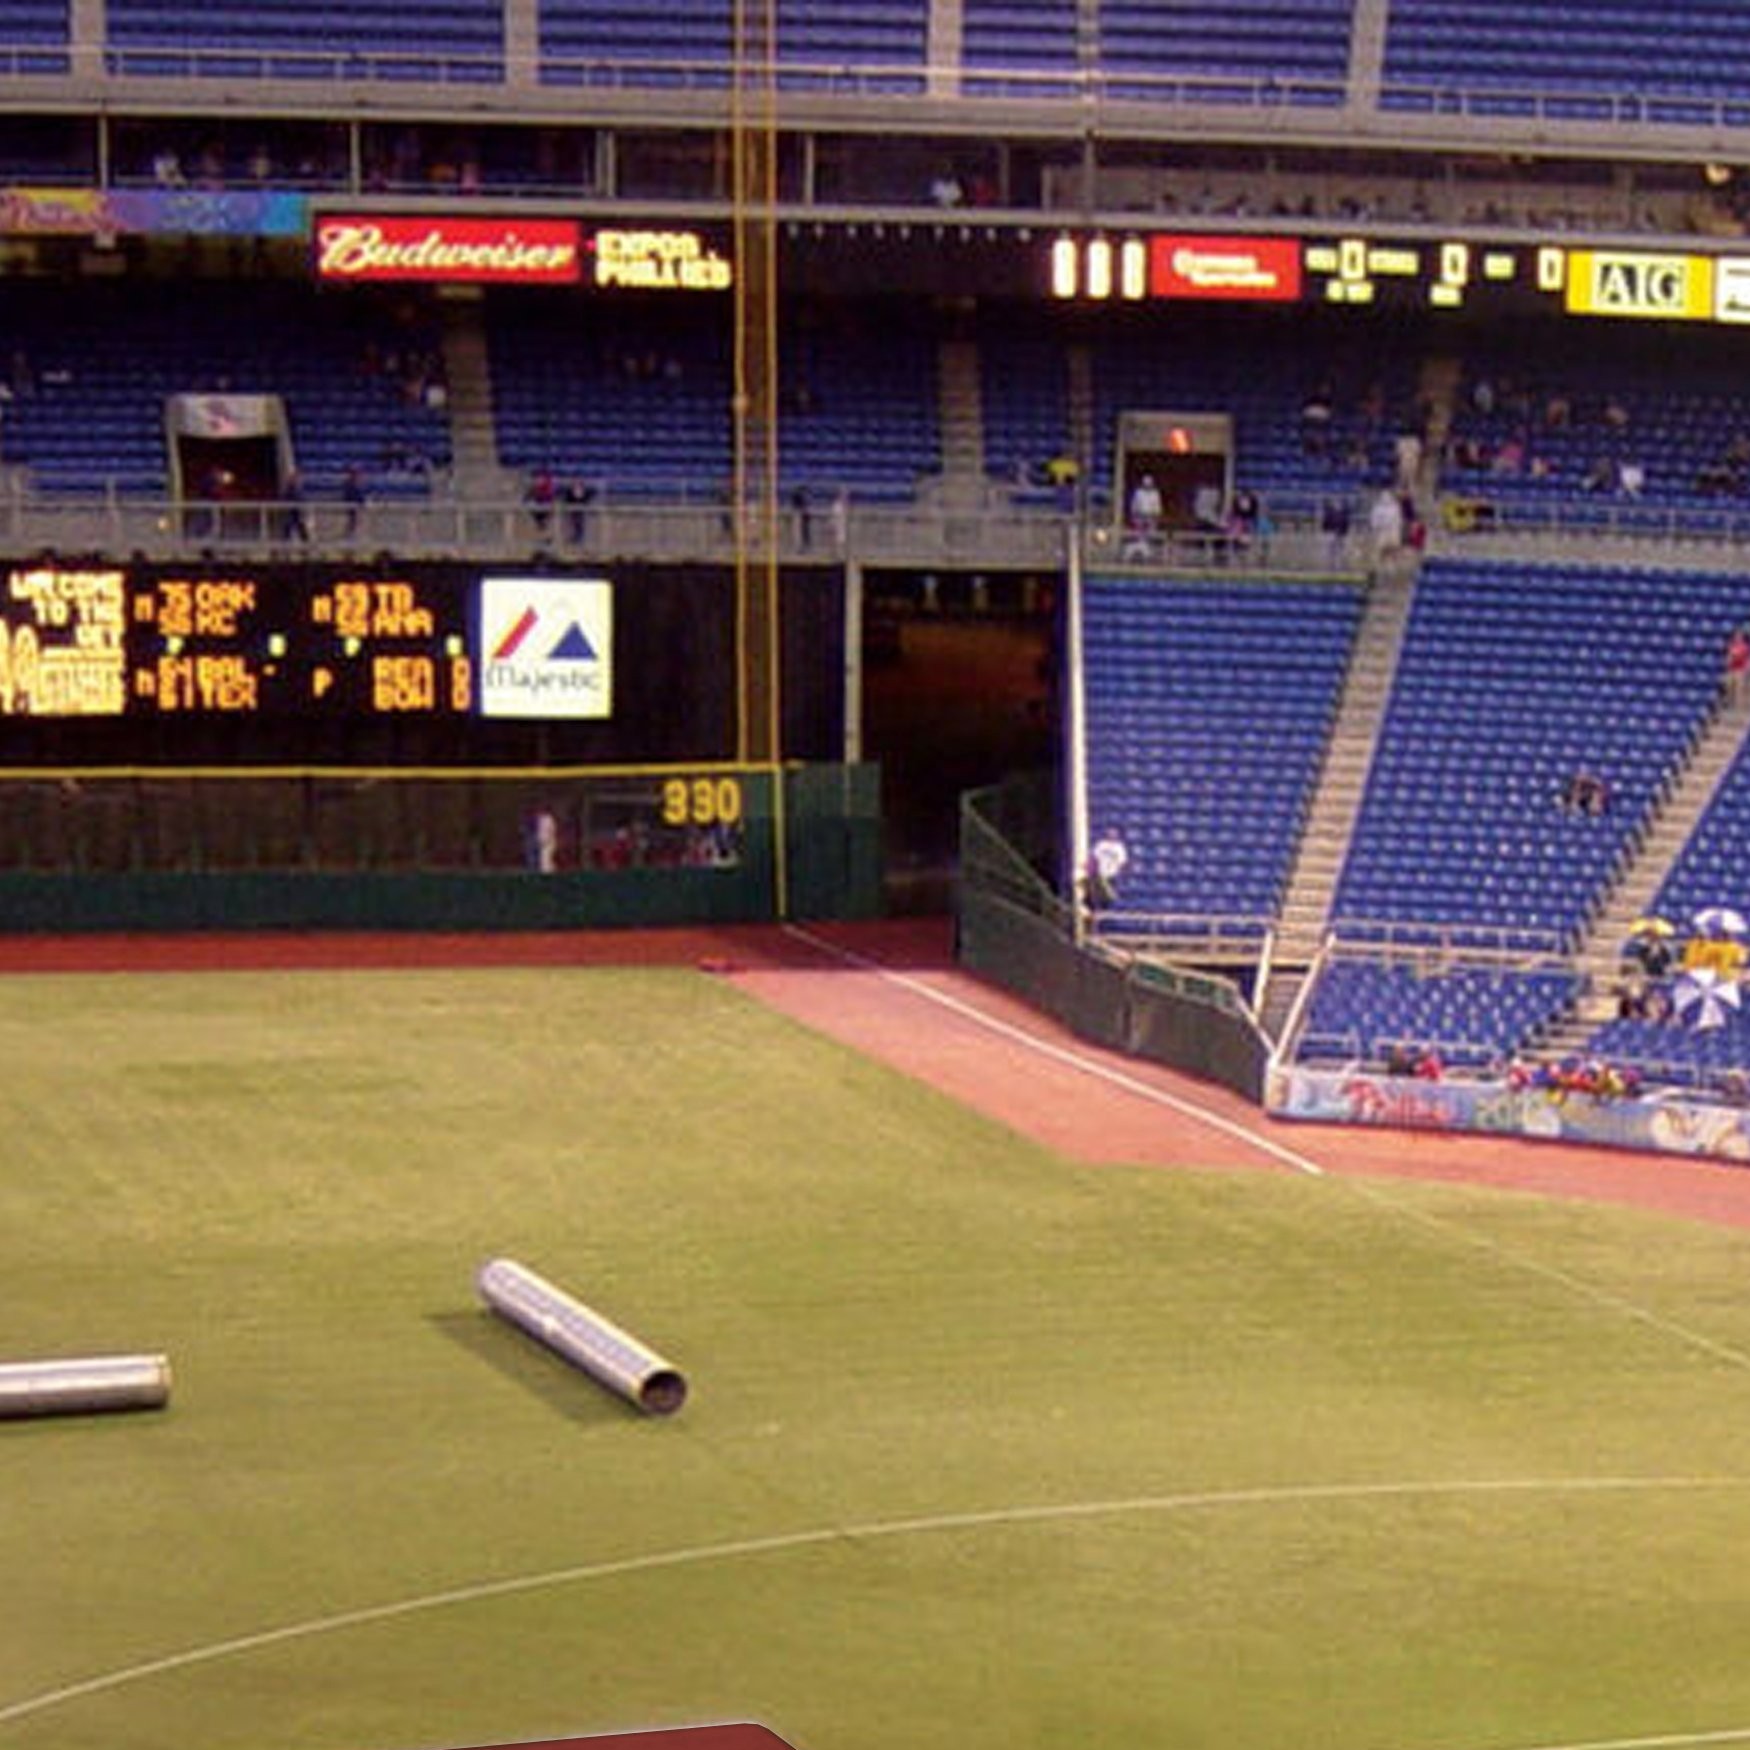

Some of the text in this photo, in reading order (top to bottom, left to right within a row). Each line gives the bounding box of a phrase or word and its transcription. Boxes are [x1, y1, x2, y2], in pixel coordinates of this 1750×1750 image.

[318, 224, 574, 273] Budweiser
[485, 664, 600, 693] Majestic
[662, 779, 741, 825] 330
